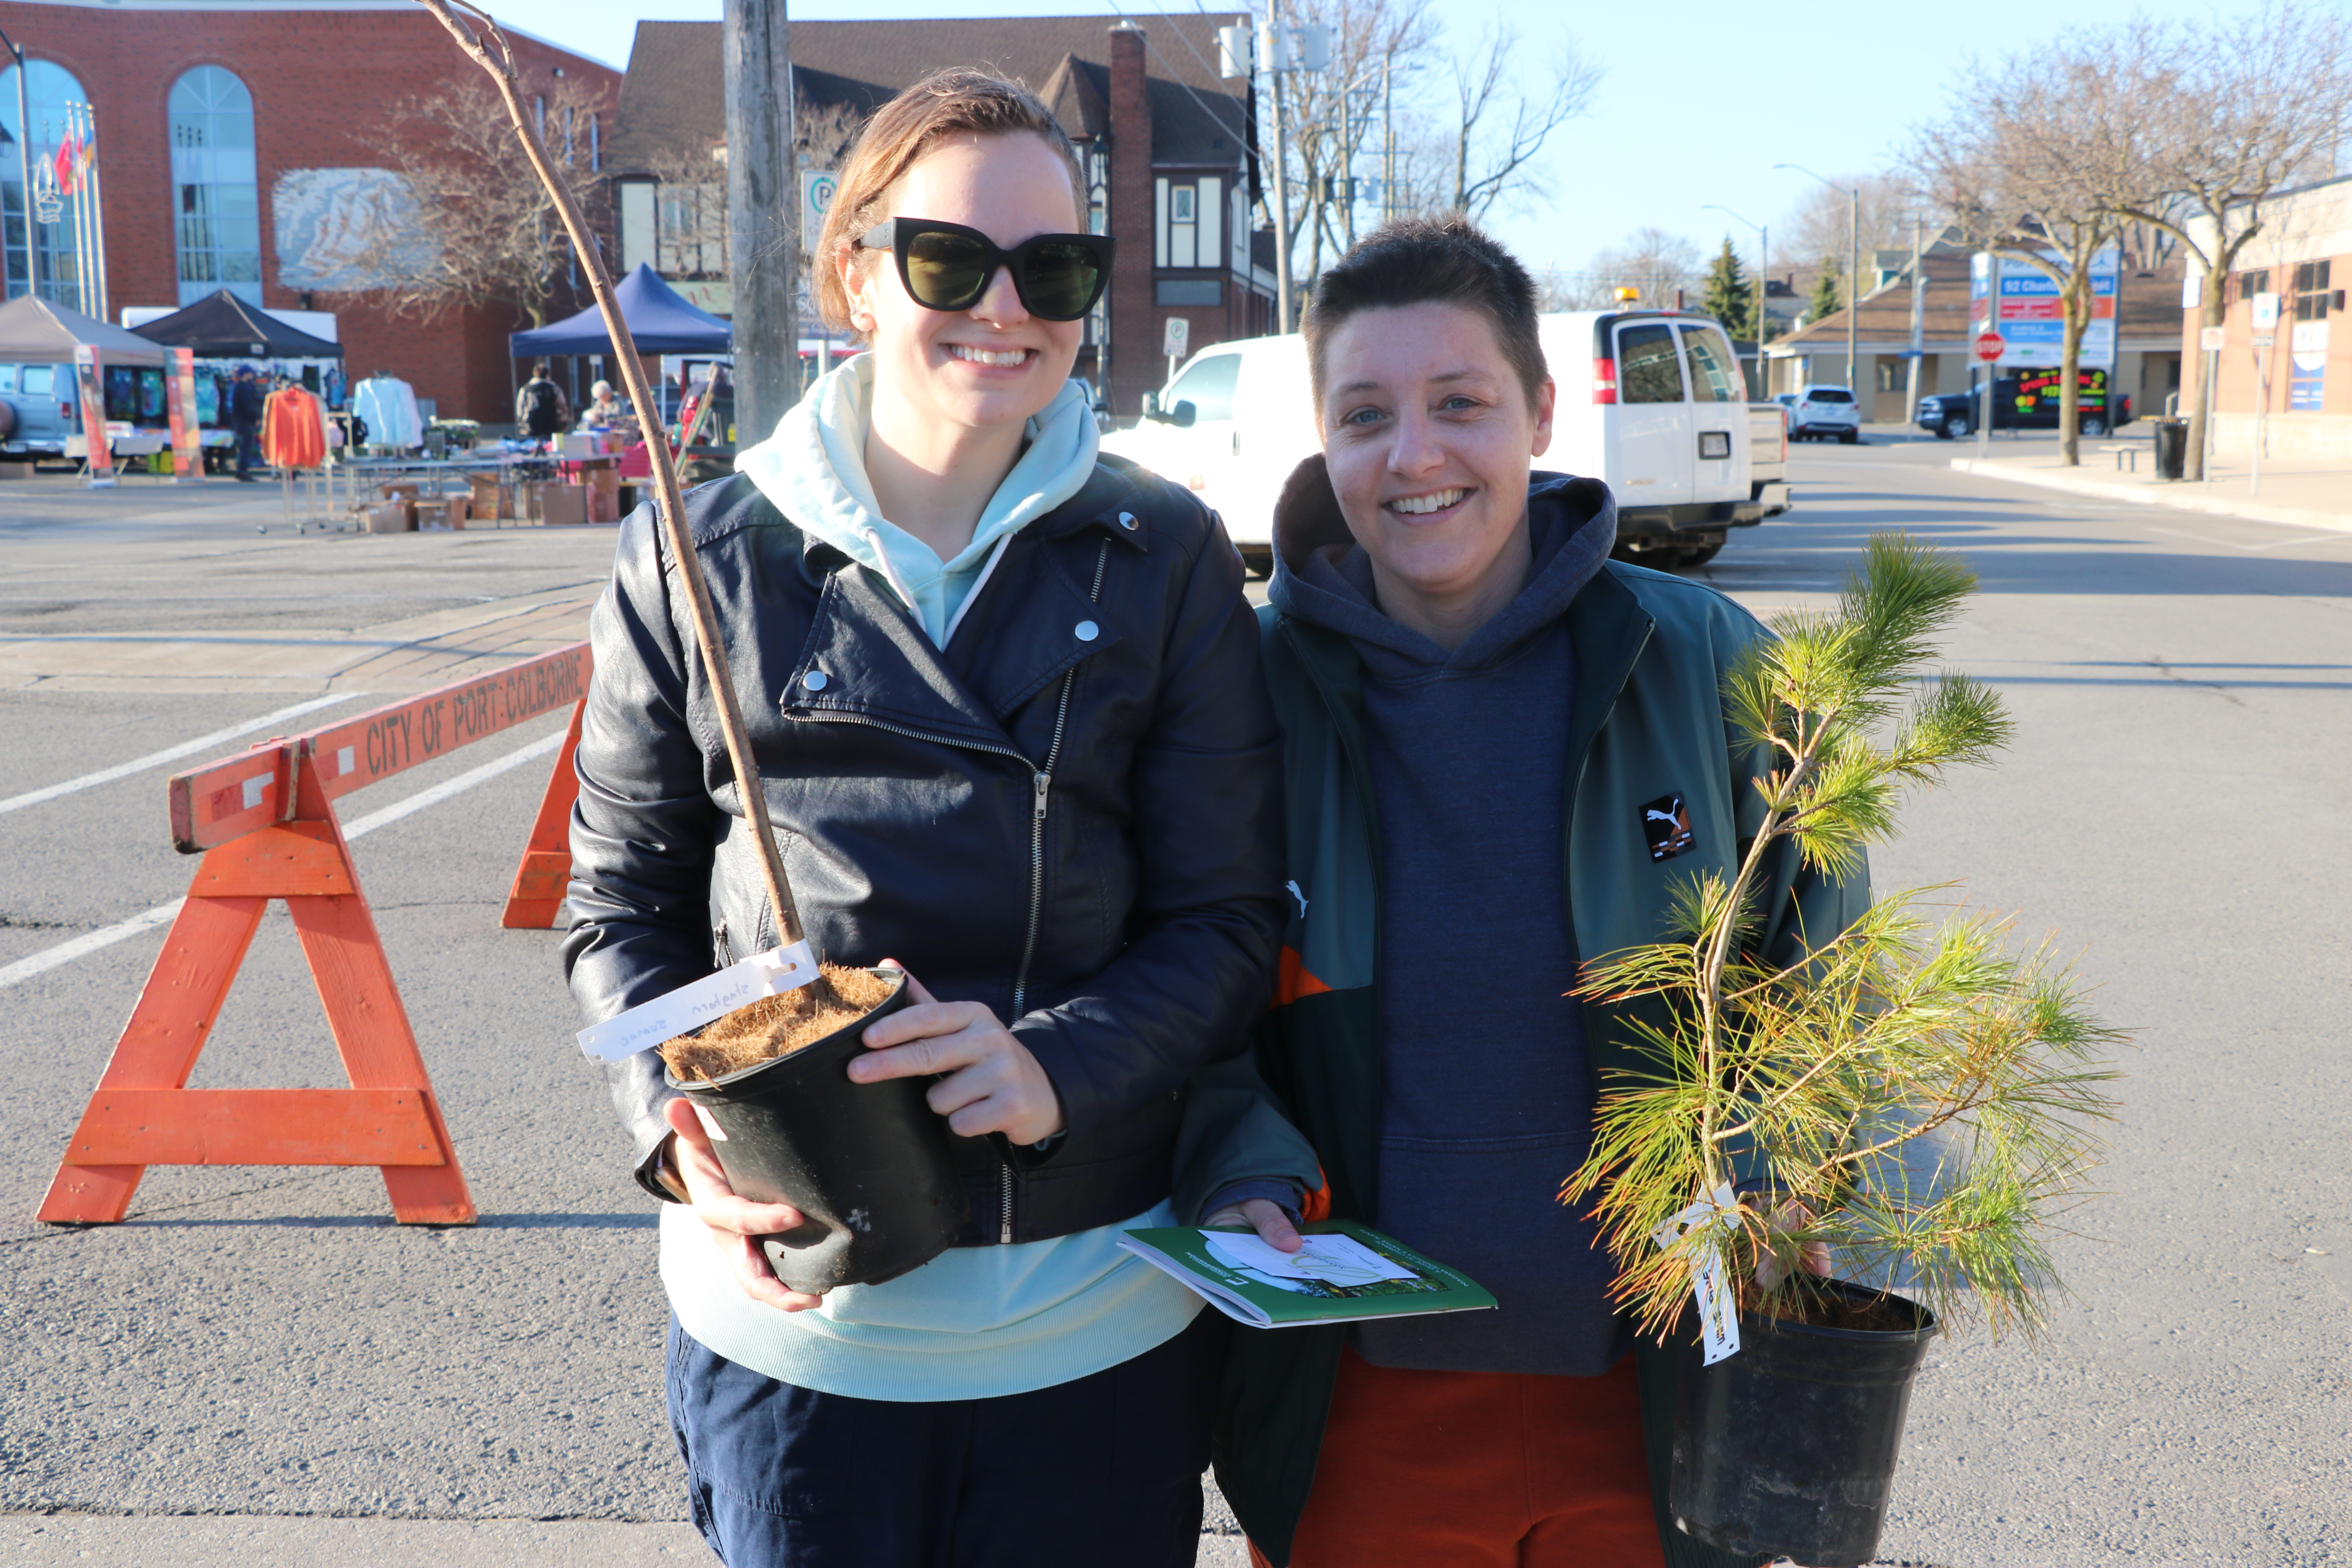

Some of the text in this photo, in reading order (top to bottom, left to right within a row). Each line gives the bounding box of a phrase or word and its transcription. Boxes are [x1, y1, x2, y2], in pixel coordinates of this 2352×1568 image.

[820, 186, 831, 205] P
[2004, 280, 2020, 292] 92
[1976, 341, 2002, 353] STOP
[367, 652, 583, 776] CITY OF PORT COLBORNE
[1440, 1269, 1468, 1287] NIAGARA
